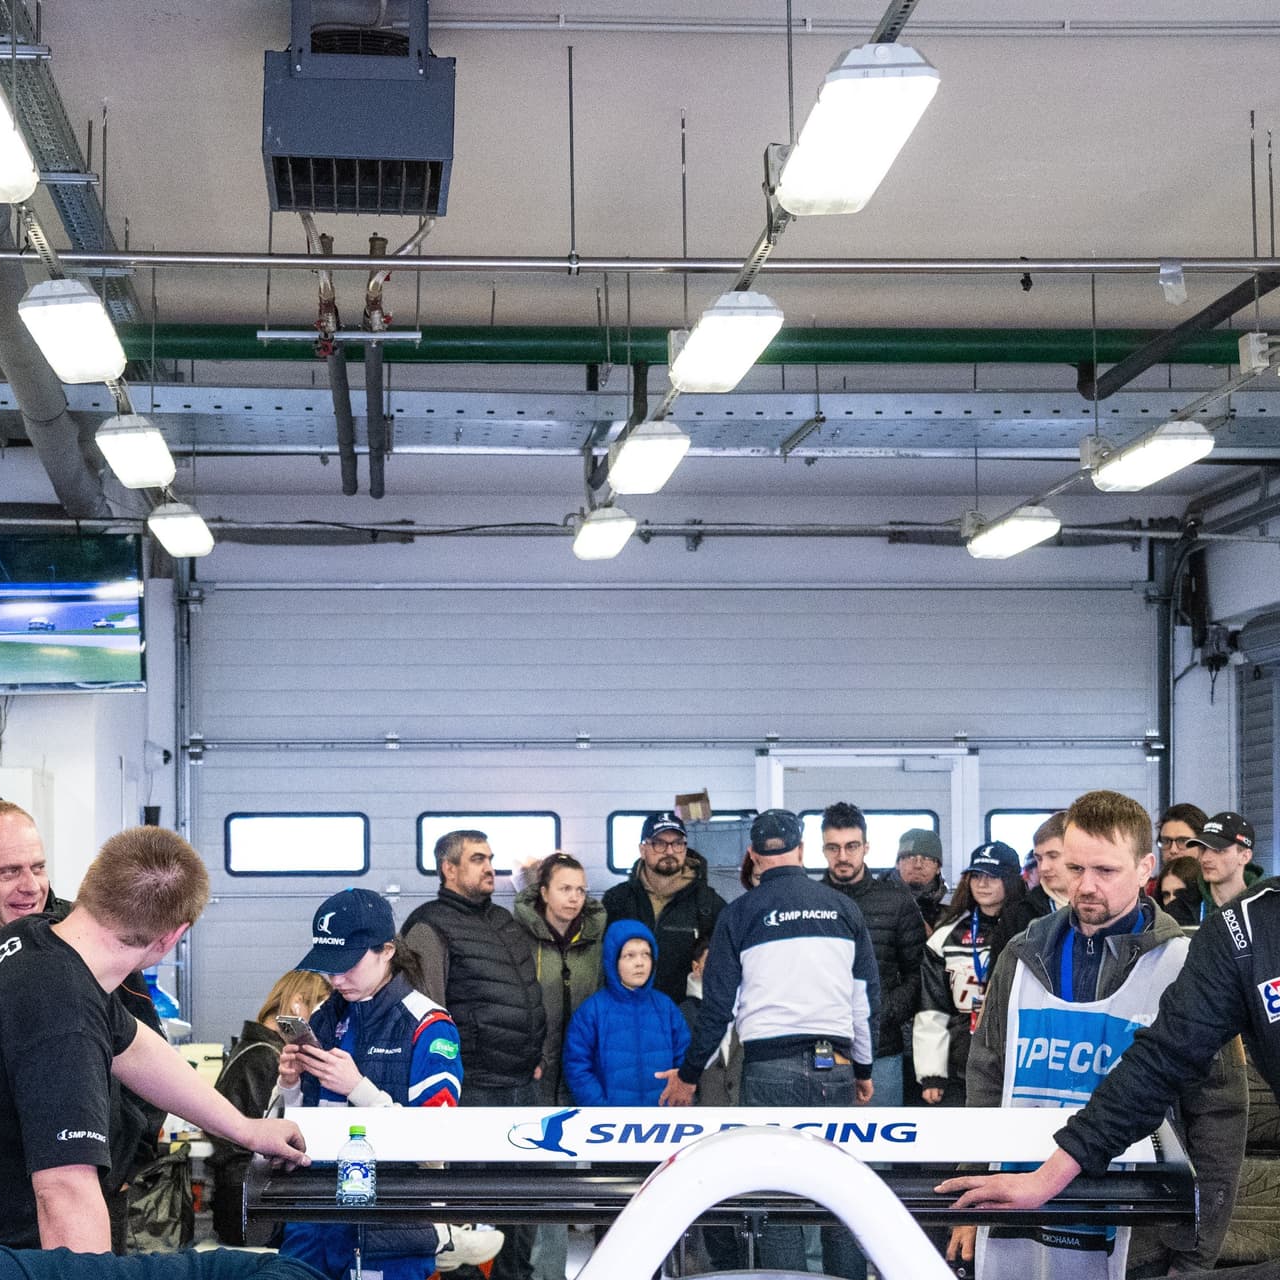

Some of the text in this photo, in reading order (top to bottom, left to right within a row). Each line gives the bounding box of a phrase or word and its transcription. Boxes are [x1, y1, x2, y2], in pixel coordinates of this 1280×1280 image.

[779, 910, 838, 922] SMP RACING
[1222, 908, 1248, 949] sparco
[1017, 1037, 1123, 1075] ПРЕСС
[68, 1131, 87, 1140] SMP
[585, 1122, 704, 1145] SMP
